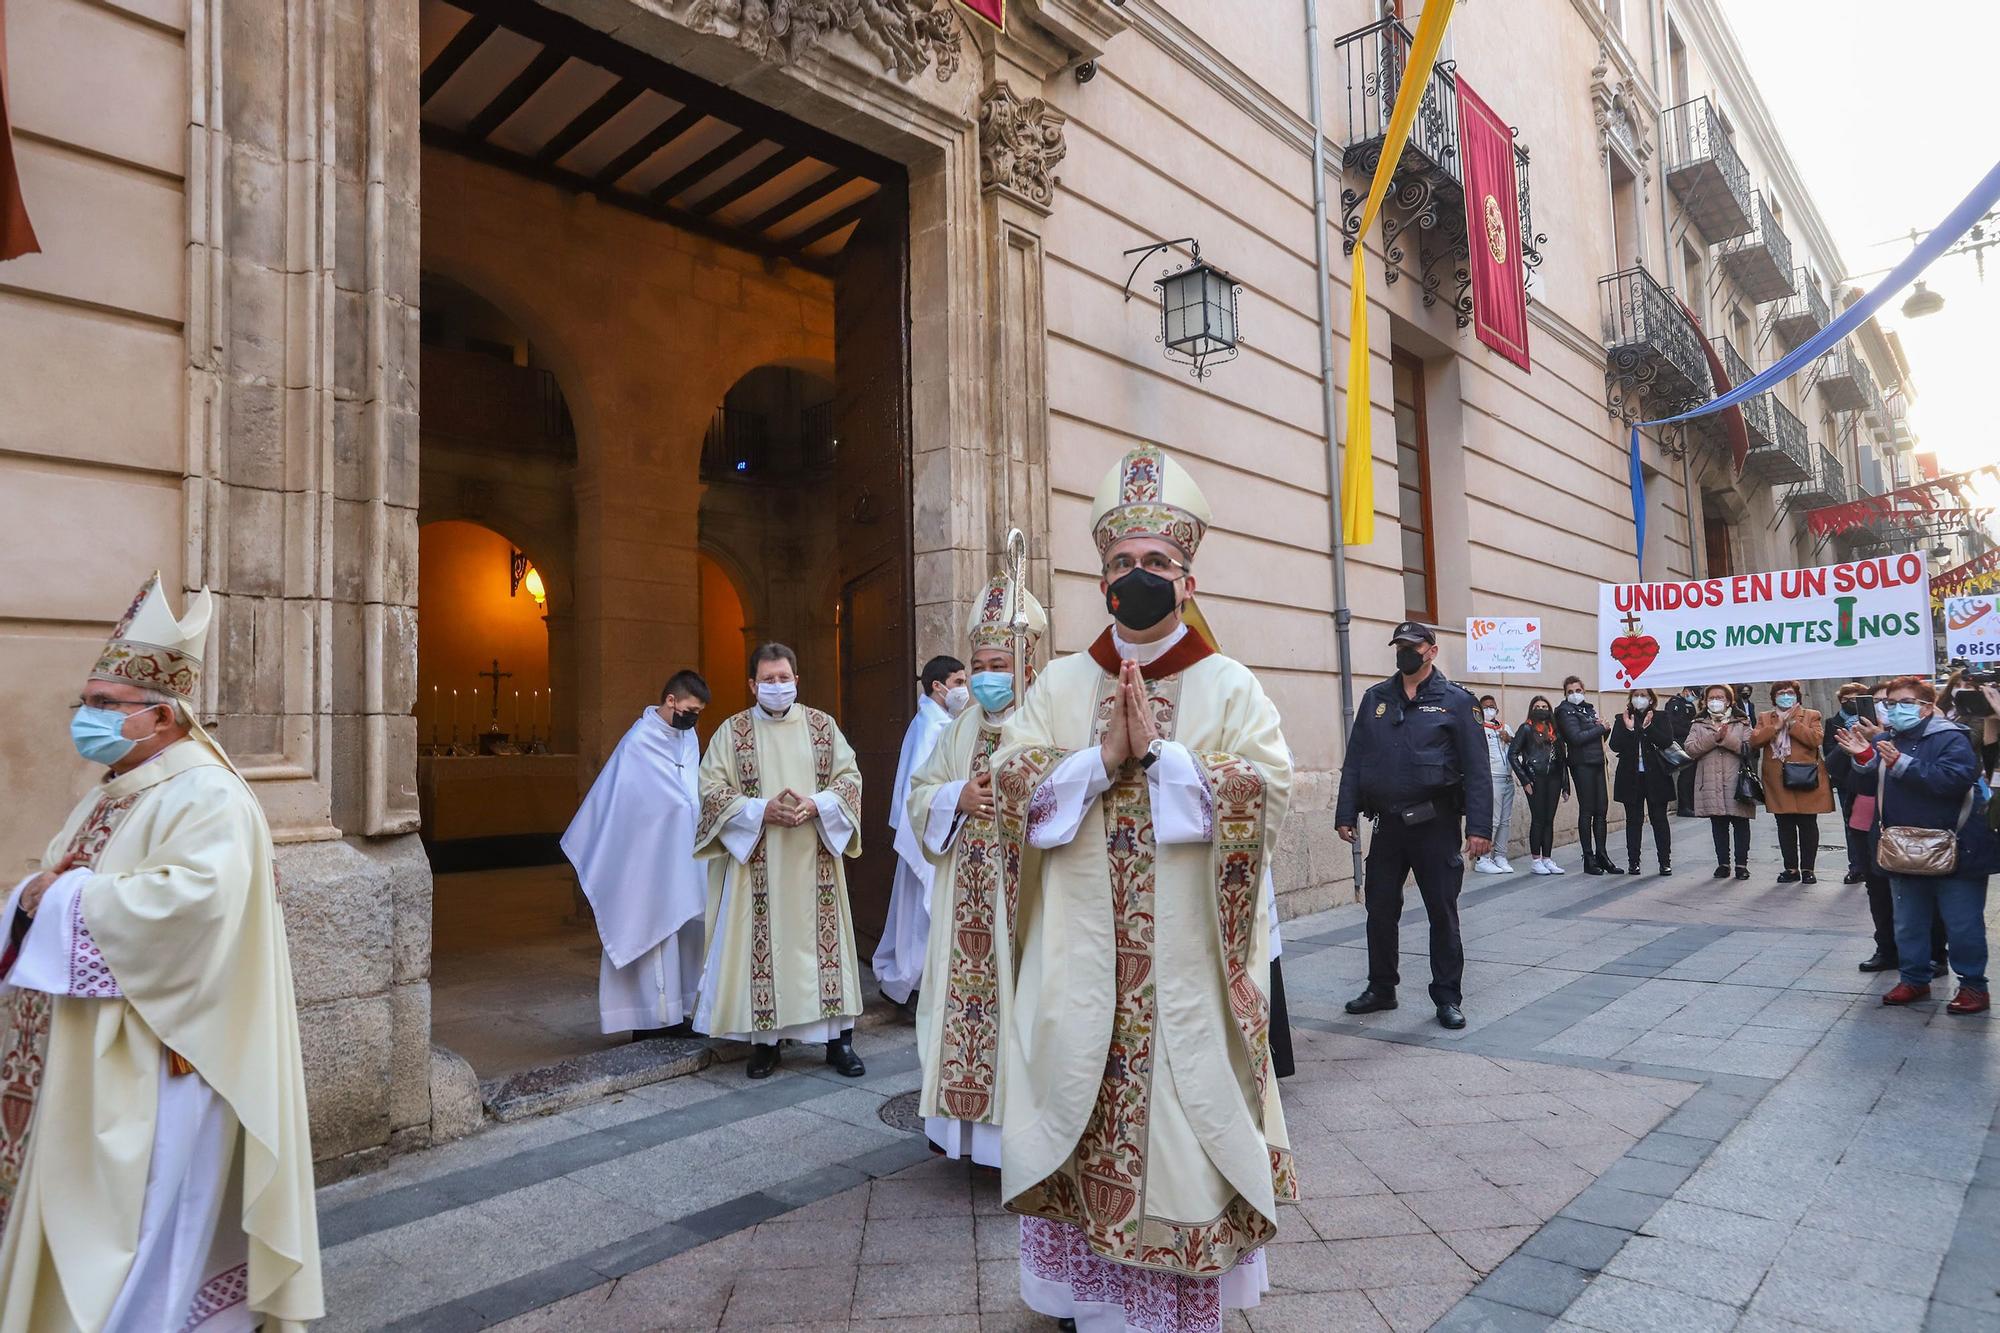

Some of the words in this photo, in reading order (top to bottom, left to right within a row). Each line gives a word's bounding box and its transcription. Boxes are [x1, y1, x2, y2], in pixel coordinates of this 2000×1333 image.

[1614, 579, 1724, 612] UNIDOS
[1732, 573, 1772, 603] EN
[1780, 567, 1826, 599] UN
[1833, 553, 1922, 593] SOLO
[1675, 628, 1716, 651] LOS
